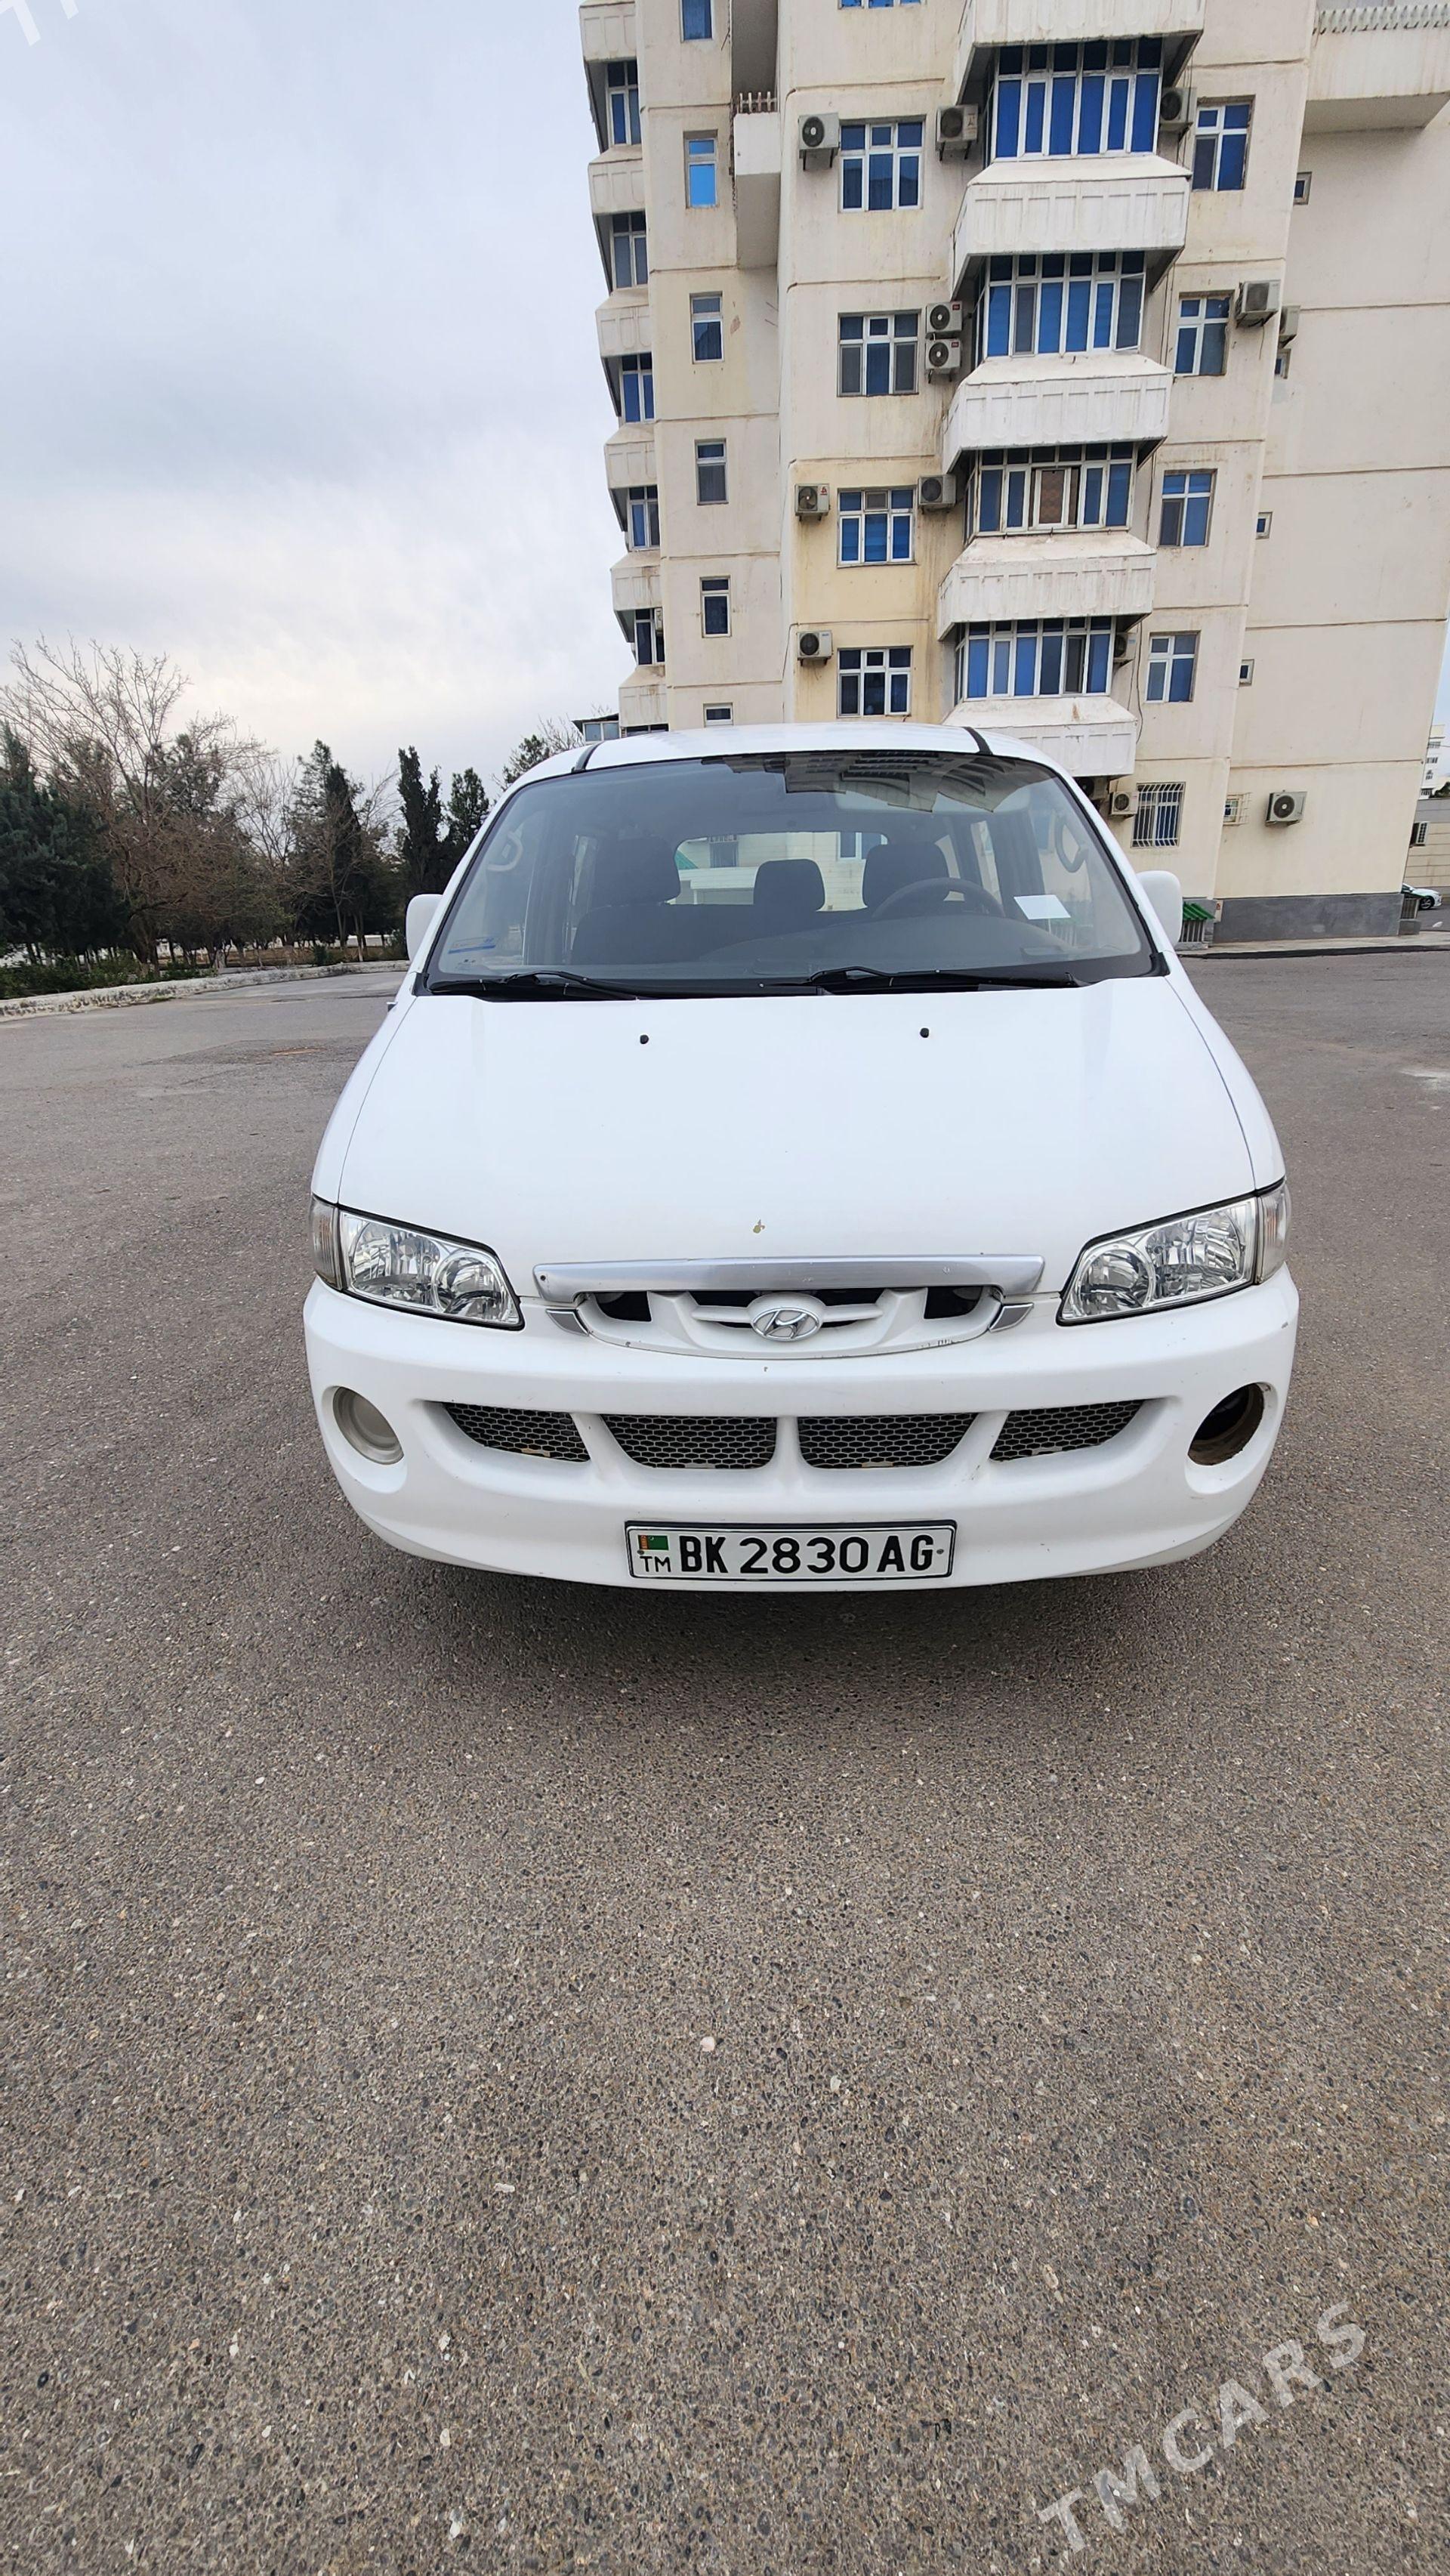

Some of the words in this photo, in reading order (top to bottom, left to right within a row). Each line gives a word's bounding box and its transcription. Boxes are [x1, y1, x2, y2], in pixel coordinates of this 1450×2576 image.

[639, 1555, 671, 1574] TM
[679, 1535, 729, 1574] BK
[739, 1537, 869, 1574] 2830
[876, 1534, 934, 1574] AG
